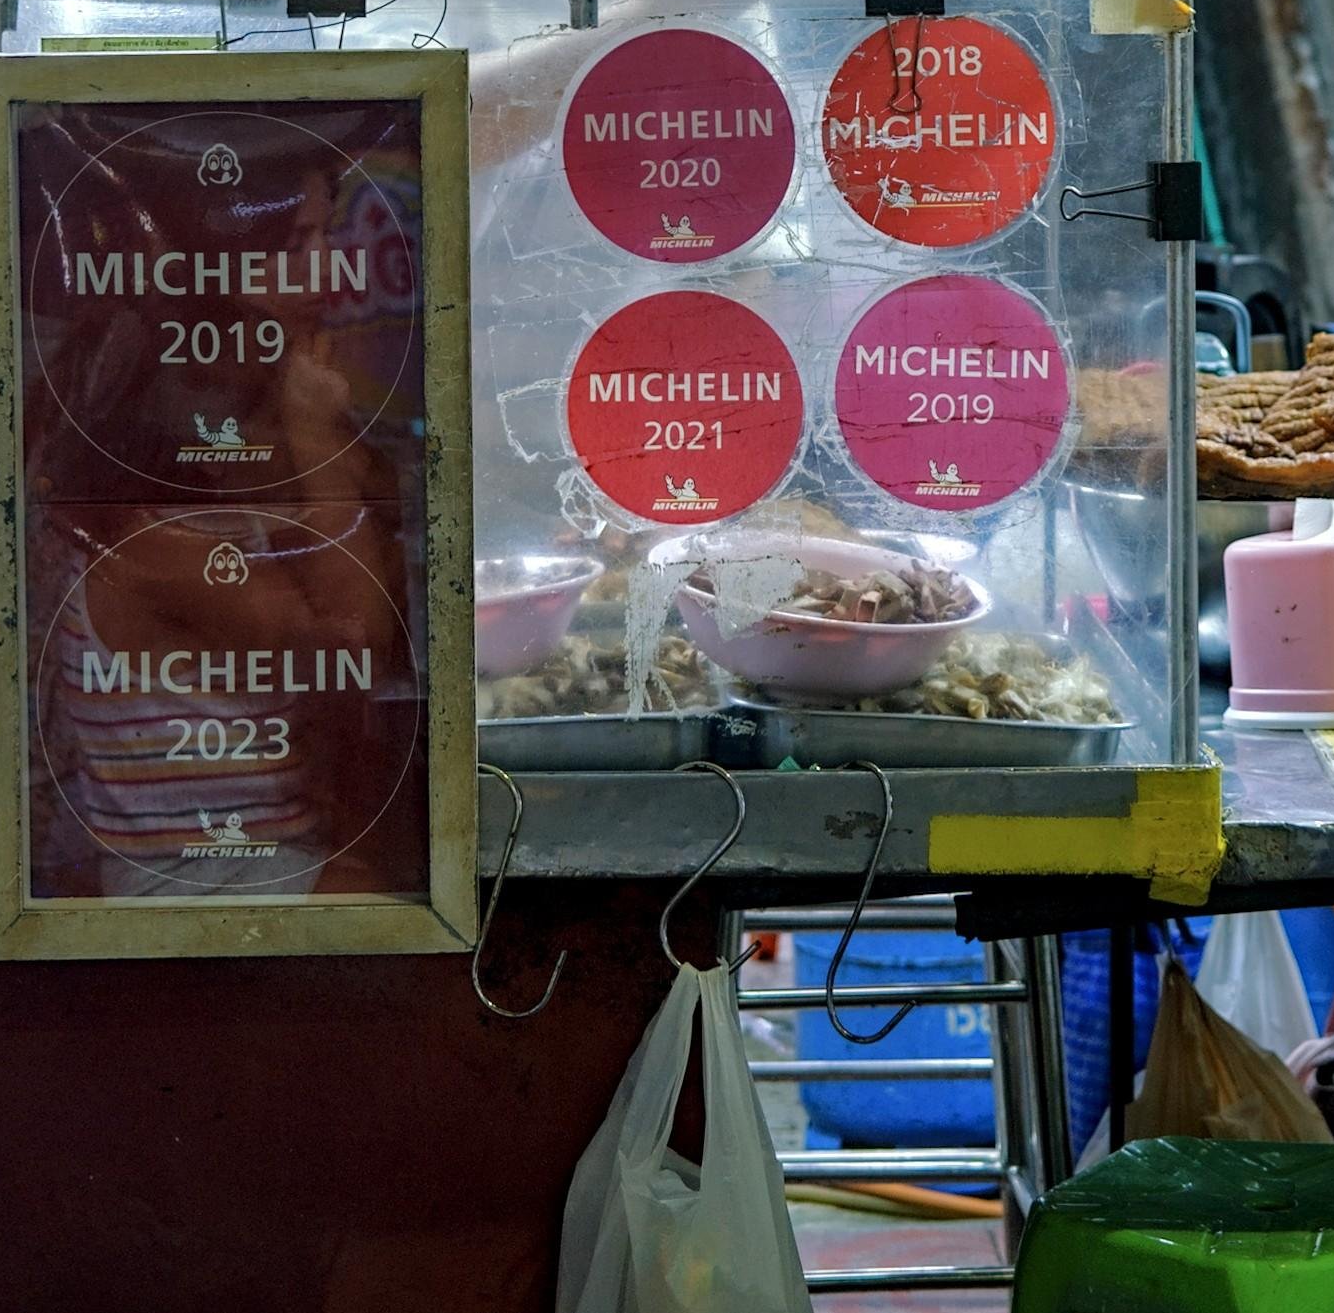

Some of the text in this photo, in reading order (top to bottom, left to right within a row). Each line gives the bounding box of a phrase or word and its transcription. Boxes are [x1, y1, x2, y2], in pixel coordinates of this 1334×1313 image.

[890, 44, 983, 78] 2018
[584, 107, 774, 143] MICHELIN
[828, 111, 1049, 150] MICHELIN
[639, 157, 721, 189] 2020
[921, 189, 1000, 205] MICHELIN
[649, 237, 714, 249] MICHELIN
[75, 248, 367, 296] MICHELIN
[159, 319, 285, 365] 2019
[854, 344, 1050, 380] MICHELIN
[588, 371, 781, 404] MICHELIN
[906, 391, 995, 426] 2019
[643, 420, 724, 452] 2021
[175, 449, 274, 463] MICHELIN
[652, 499, 718, 512] MICHELIN
[914, 485, 981, 498] MICHELIN
[82, 647, 373, 695] MICHELIN
[166, 717, 291, 763] 2023
[180, 844, 279, 860] MICHELIN
